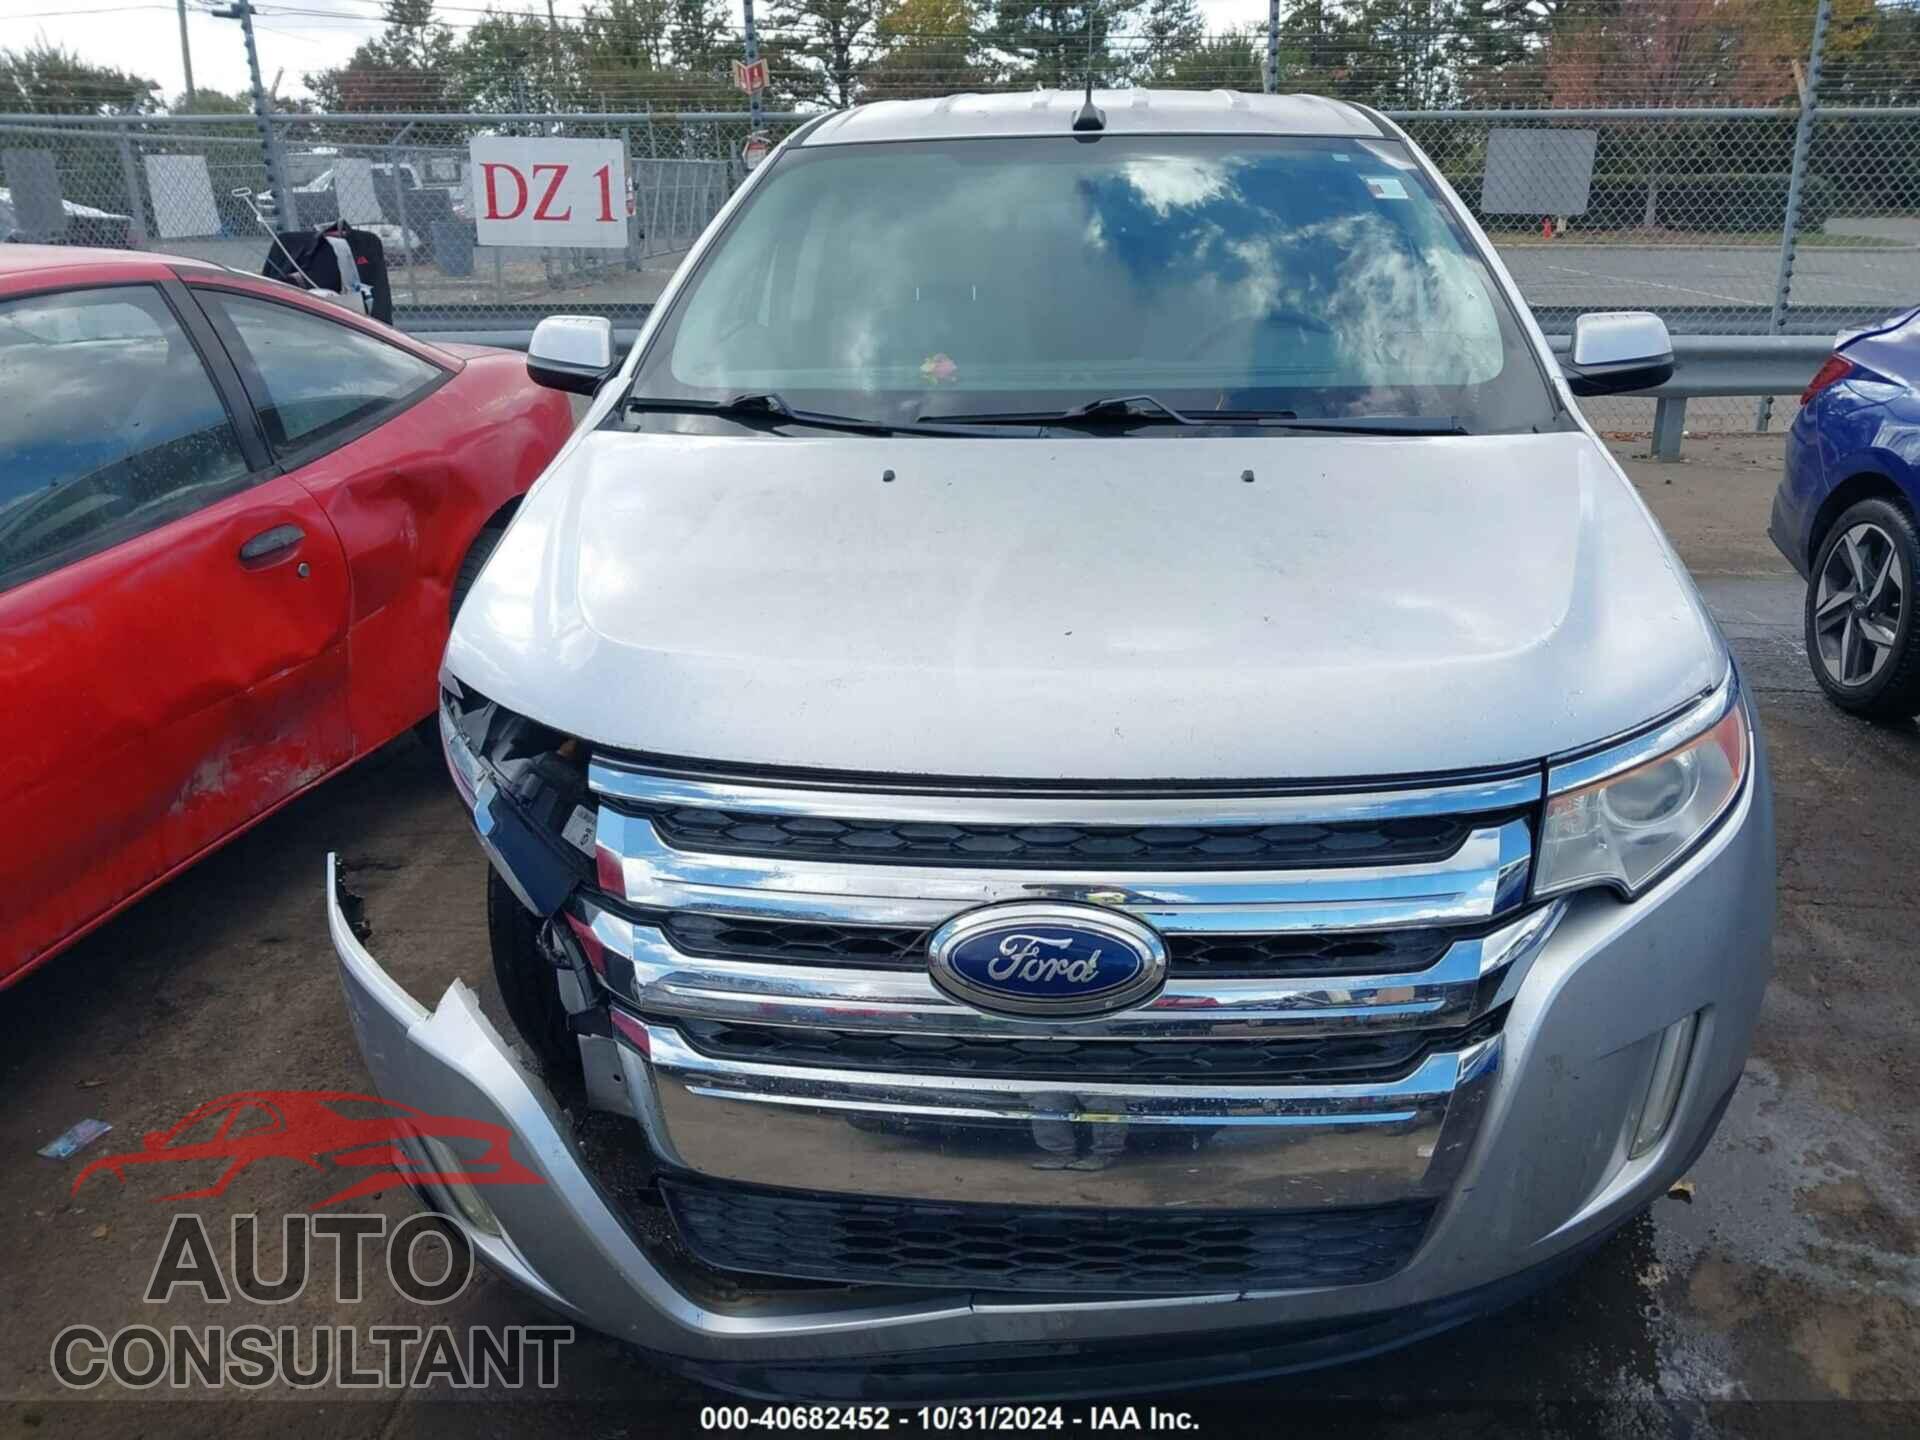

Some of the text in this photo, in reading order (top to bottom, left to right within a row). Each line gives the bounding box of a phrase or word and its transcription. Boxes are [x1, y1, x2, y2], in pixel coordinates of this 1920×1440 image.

[479, 161, 619, 223] DZ 1
[988, 934, 1101, 982] Ford
